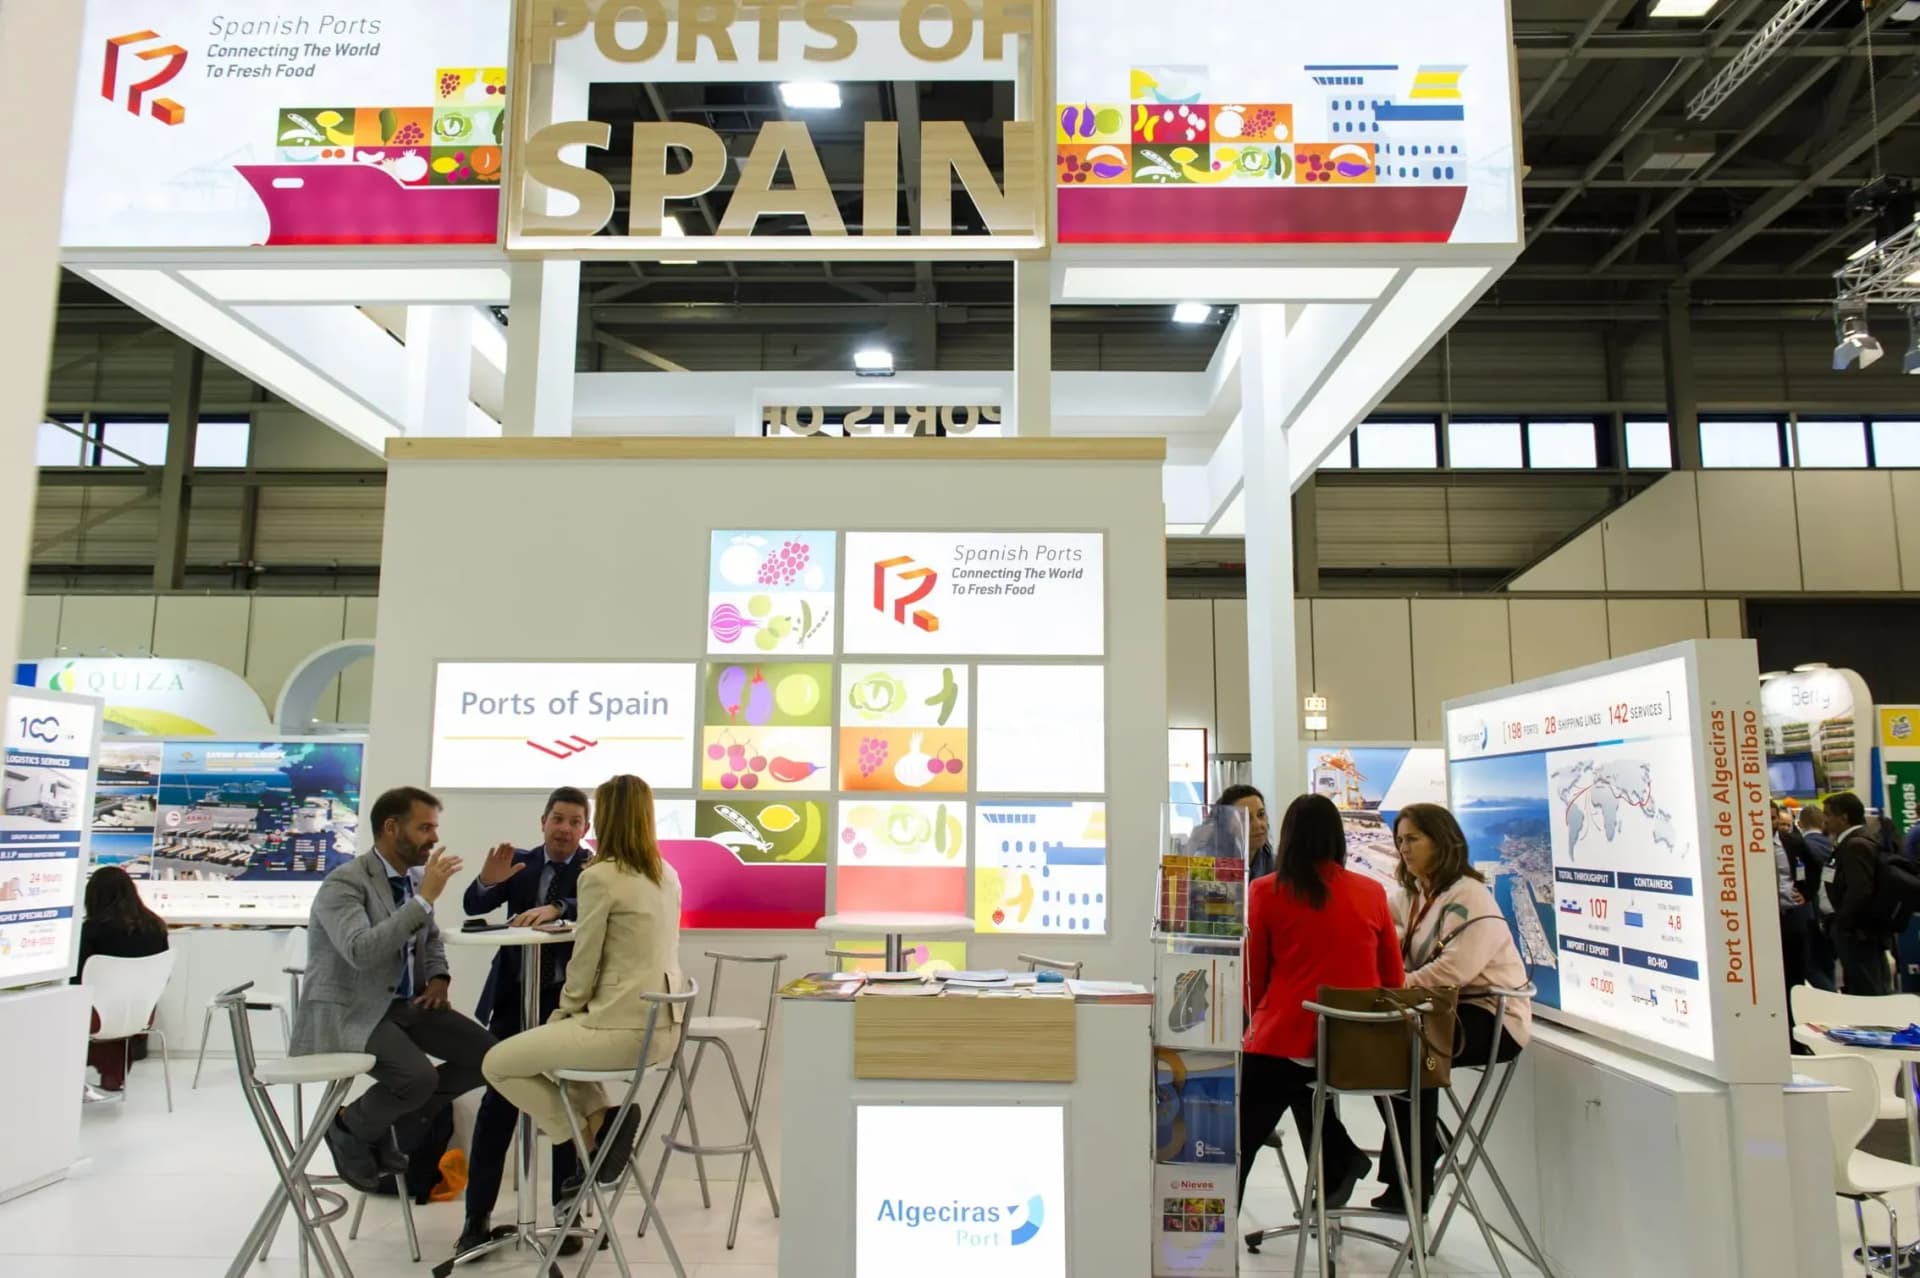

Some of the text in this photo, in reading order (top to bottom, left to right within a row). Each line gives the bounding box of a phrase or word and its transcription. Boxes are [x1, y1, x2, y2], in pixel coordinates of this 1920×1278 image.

[208, 15, 383, 41] Spanish Ports
[531, 0, 1034, 64] PORTS OF
[206, 42, 382, 61] Connecting The World
[206, 63, 316, 78] To Fresh Food
[520, 120, 1036, 237] SPAIN
[953, 544, 1083, 565] Spanish Ports
[951, 567, 1083, 582] Connecting The World
[951, 584, 1036, 595] To Fresh Food
[87, 671, 184, 693] QUIZA
[461, 690, 668, 721] Ports of Spain
[1544, 716, 1557, 735] 28
[1584, 713, 1601, 726] LINES
[1608, 703, 1629, 725] 142
[1709, 710, 1733, 804] Algeciras
[1741, 710, 1766, 853] Port of Bilbao
[1714, 811, 1733, 837] de
[1574, 872, 1609, 884] THROUGHPUT
[1633, 878, 1673, 890] CONTAINERS
[1589, 898, 1607, 919] 107
[1720, 909, 1739, 932] of
[1589, 945, 1609, 957] EXPORT
[1727, 939, 1743, 983] Port
[1647, 956, 1668, 969] RO-RO
[1181, 1180, 1215, 1190] Nieves
[877, 1199, 1001, 1227] Algeciras
[956, 1229, 1001, 1247] Port
